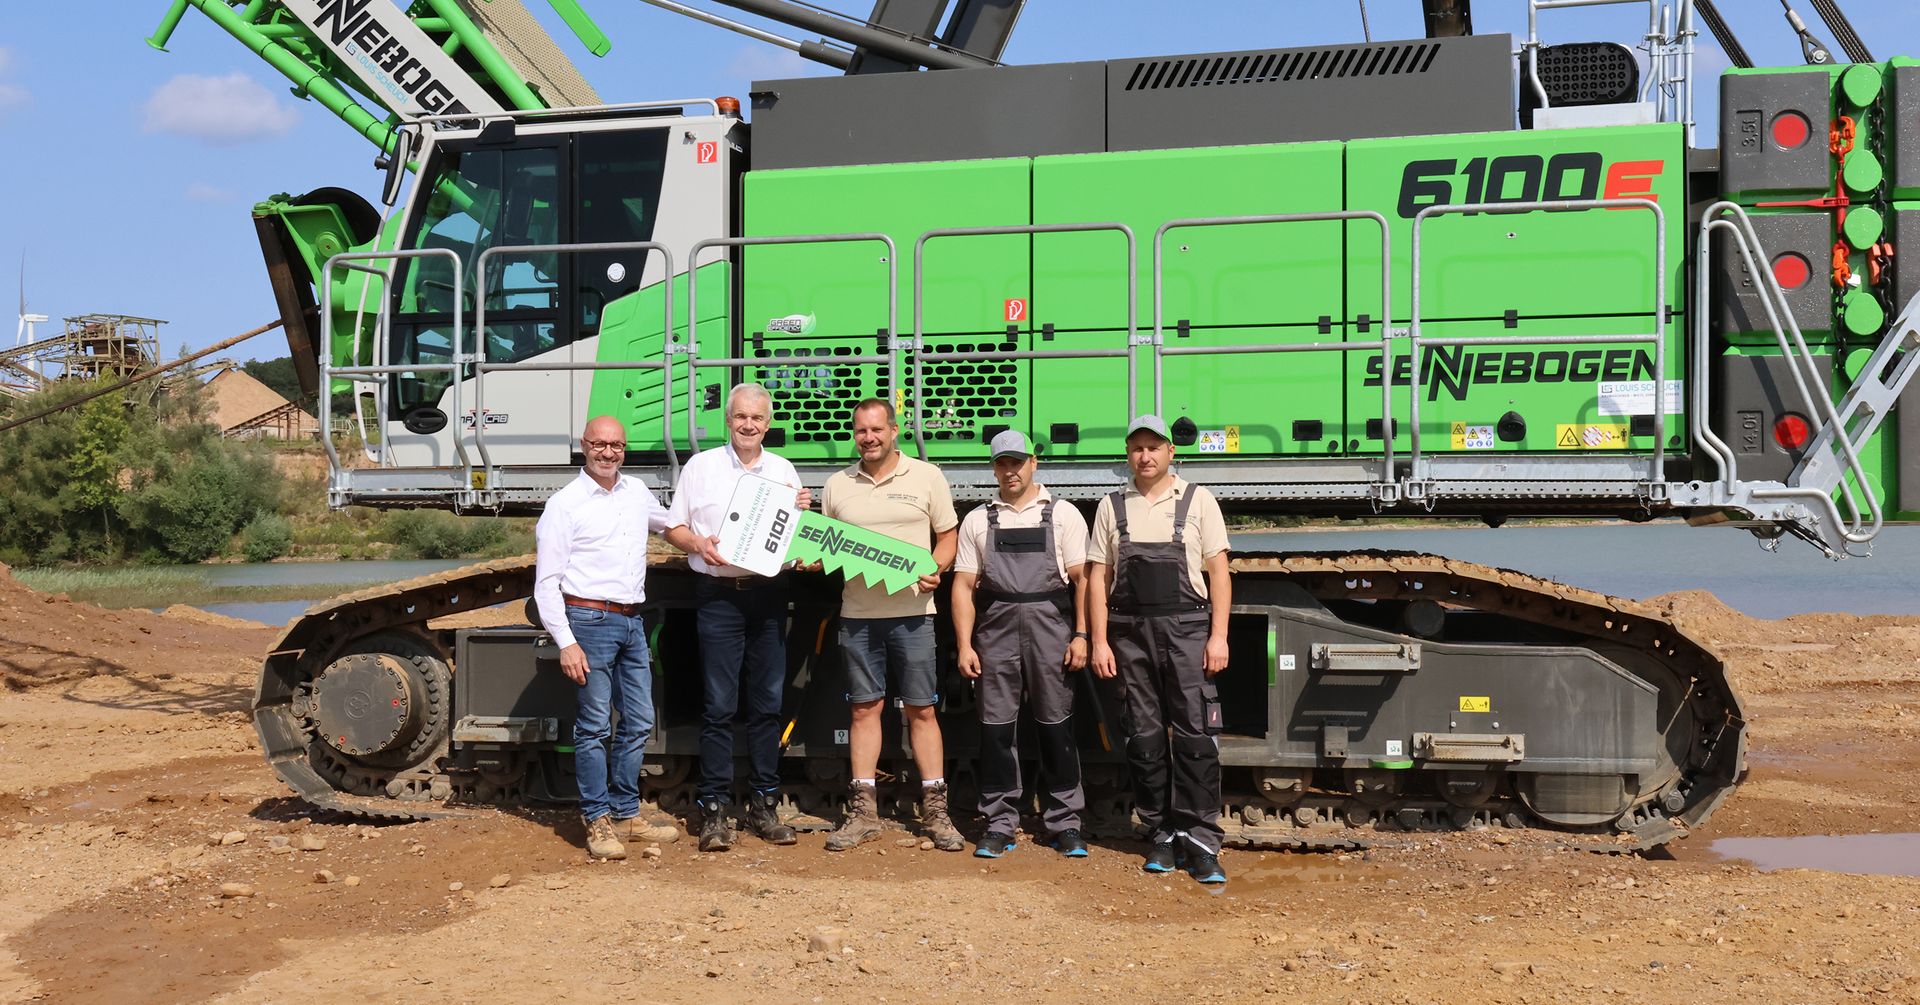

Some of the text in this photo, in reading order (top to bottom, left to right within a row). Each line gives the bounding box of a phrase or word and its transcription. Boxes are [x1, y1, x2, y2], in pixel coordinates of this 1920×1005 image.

[356, 52, 376, 74] LOUIS
[375, 70, 408, 104] SCHEUCH
[1615, 383, 1640, 392] LOUIS
[1641, 382, 1680, 391] SCHUCH
[764, 508, 790, 554] 6100
[798, 526, 917, 574] SENNEBOGEN
